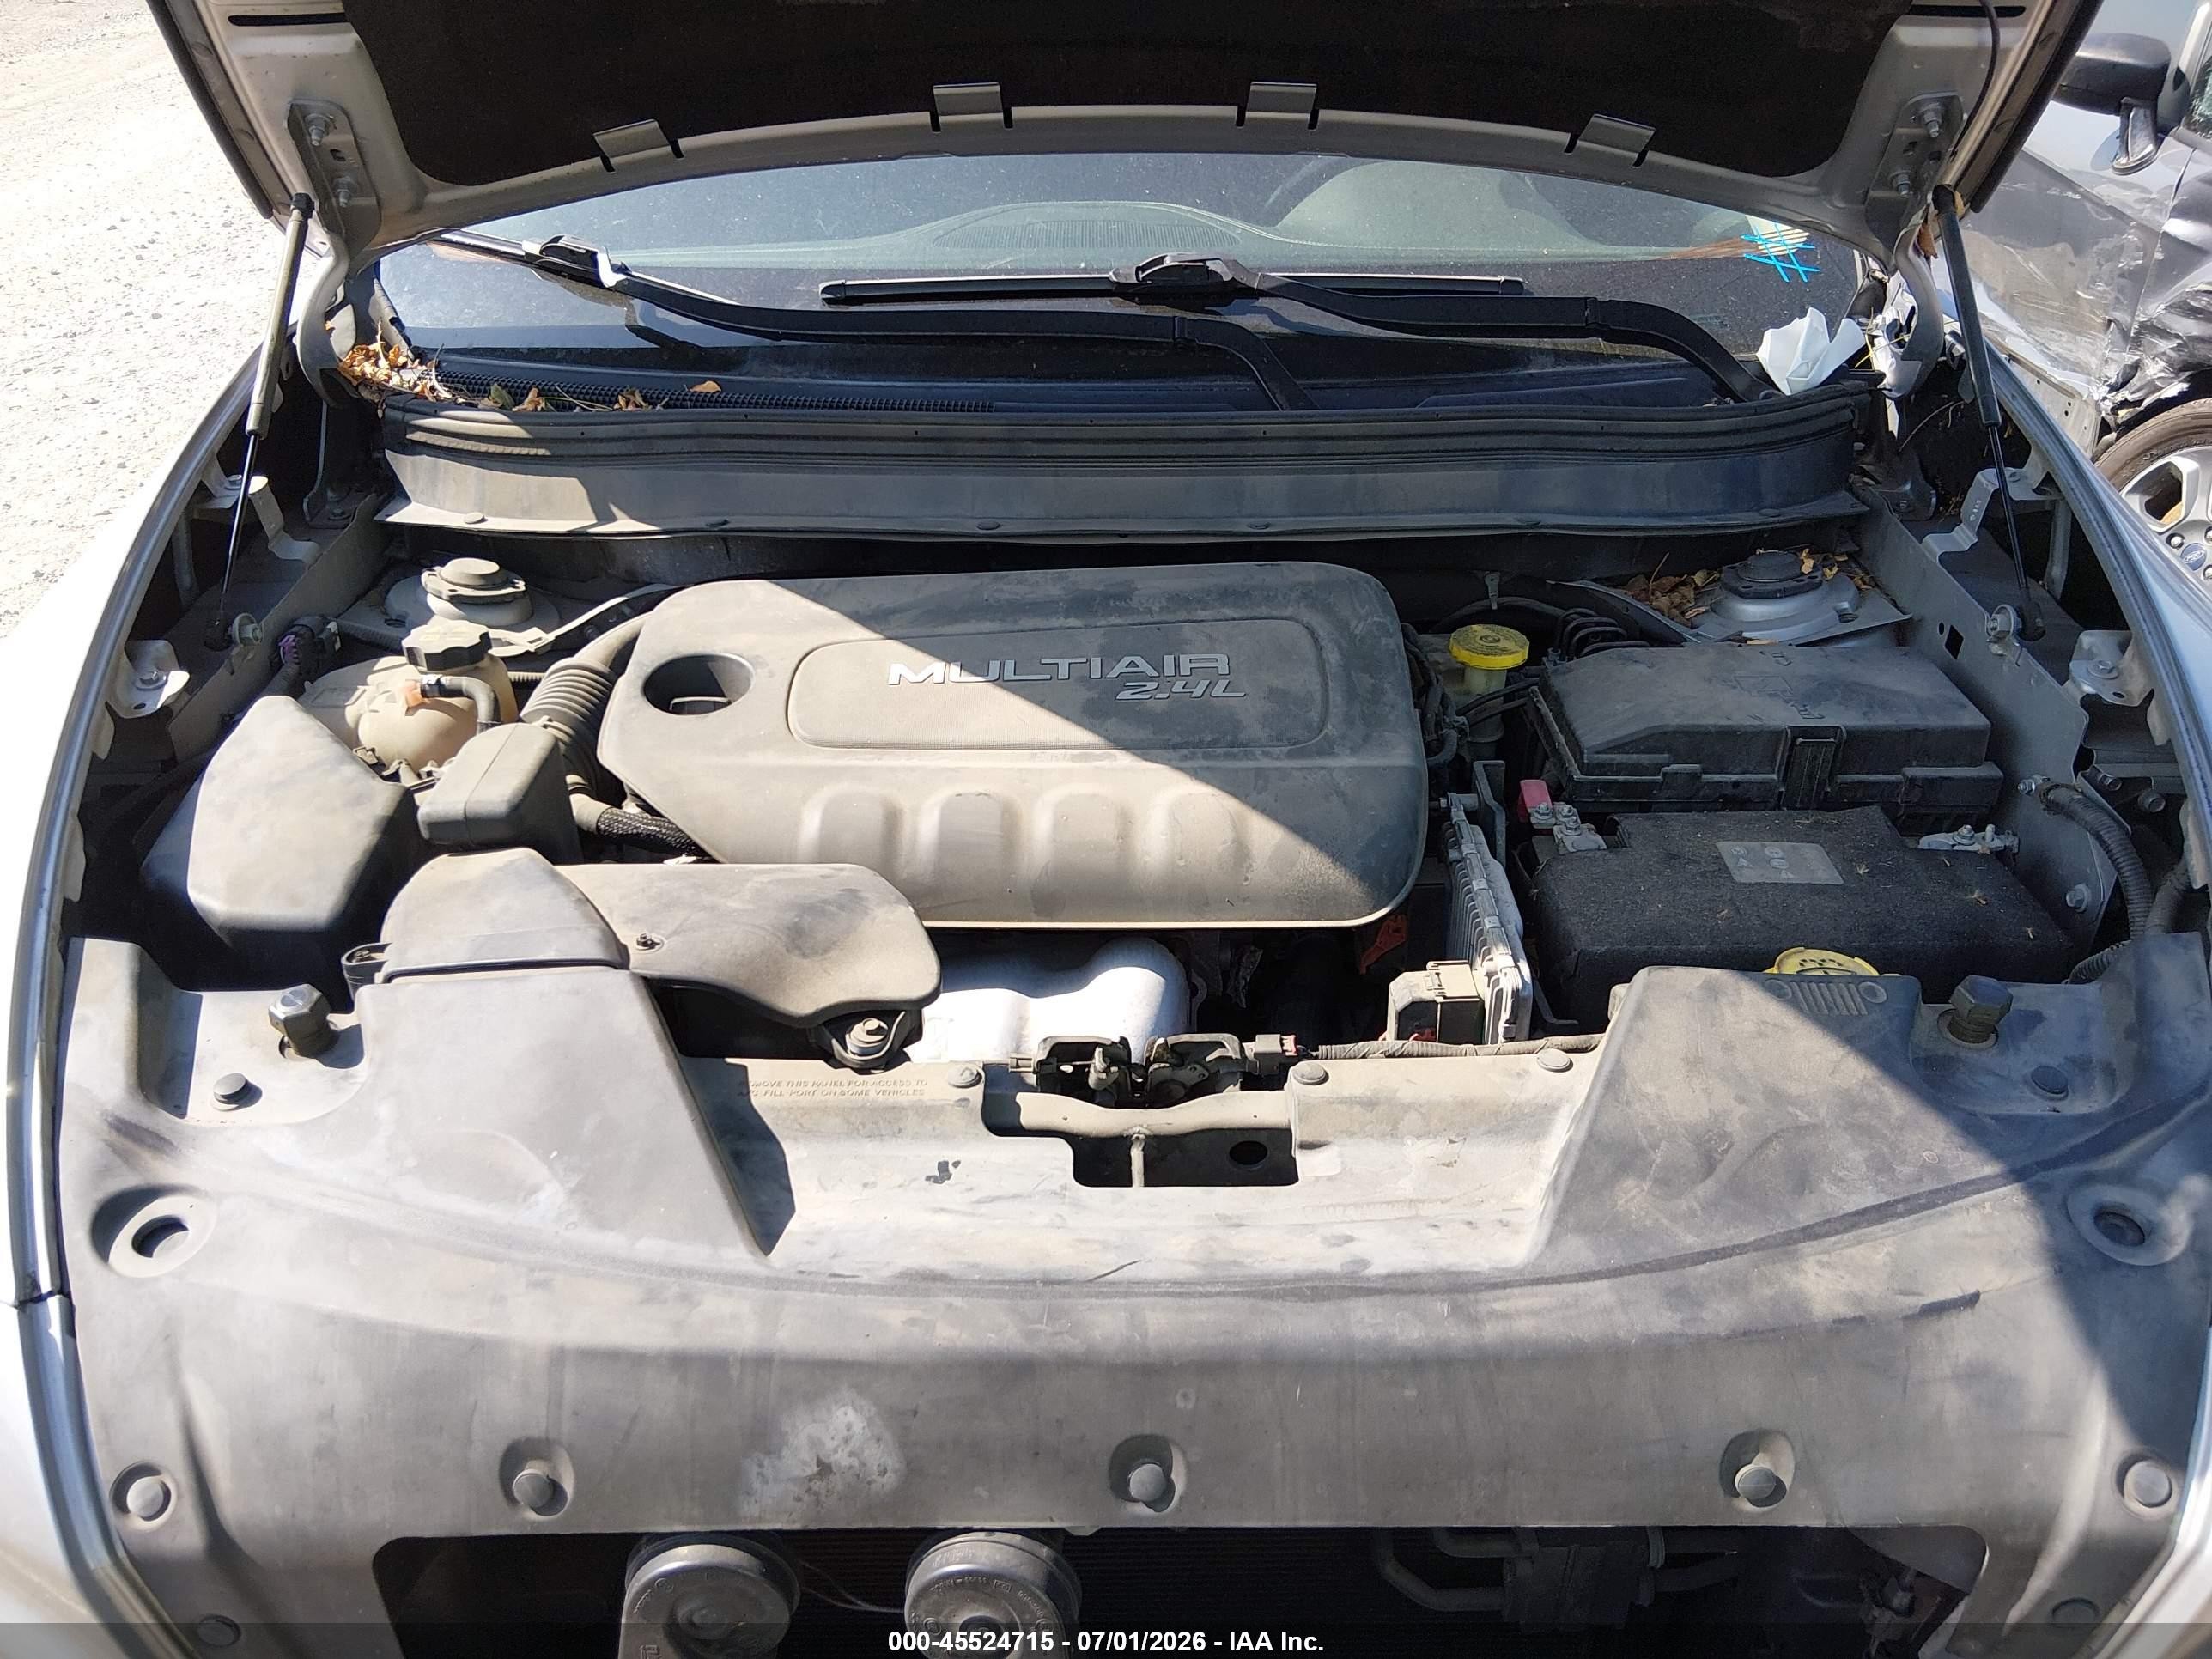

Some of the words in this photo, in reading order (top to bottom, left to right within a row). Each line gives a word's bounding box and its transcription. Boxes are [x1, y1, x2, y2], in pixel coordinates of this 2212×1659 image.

[887, 653, 1231, 685] MULTIAIR
[1115, 679, 1246, 701] 2.4L
[785, 1079, 810, 1088] THIS
[811, 1079, 845, 1088] PANEL
[915, 1079, 928, 1087] TO
[763, 1089, 784, 1097] FILL
[789, 1089, 817, 1097] PORT
